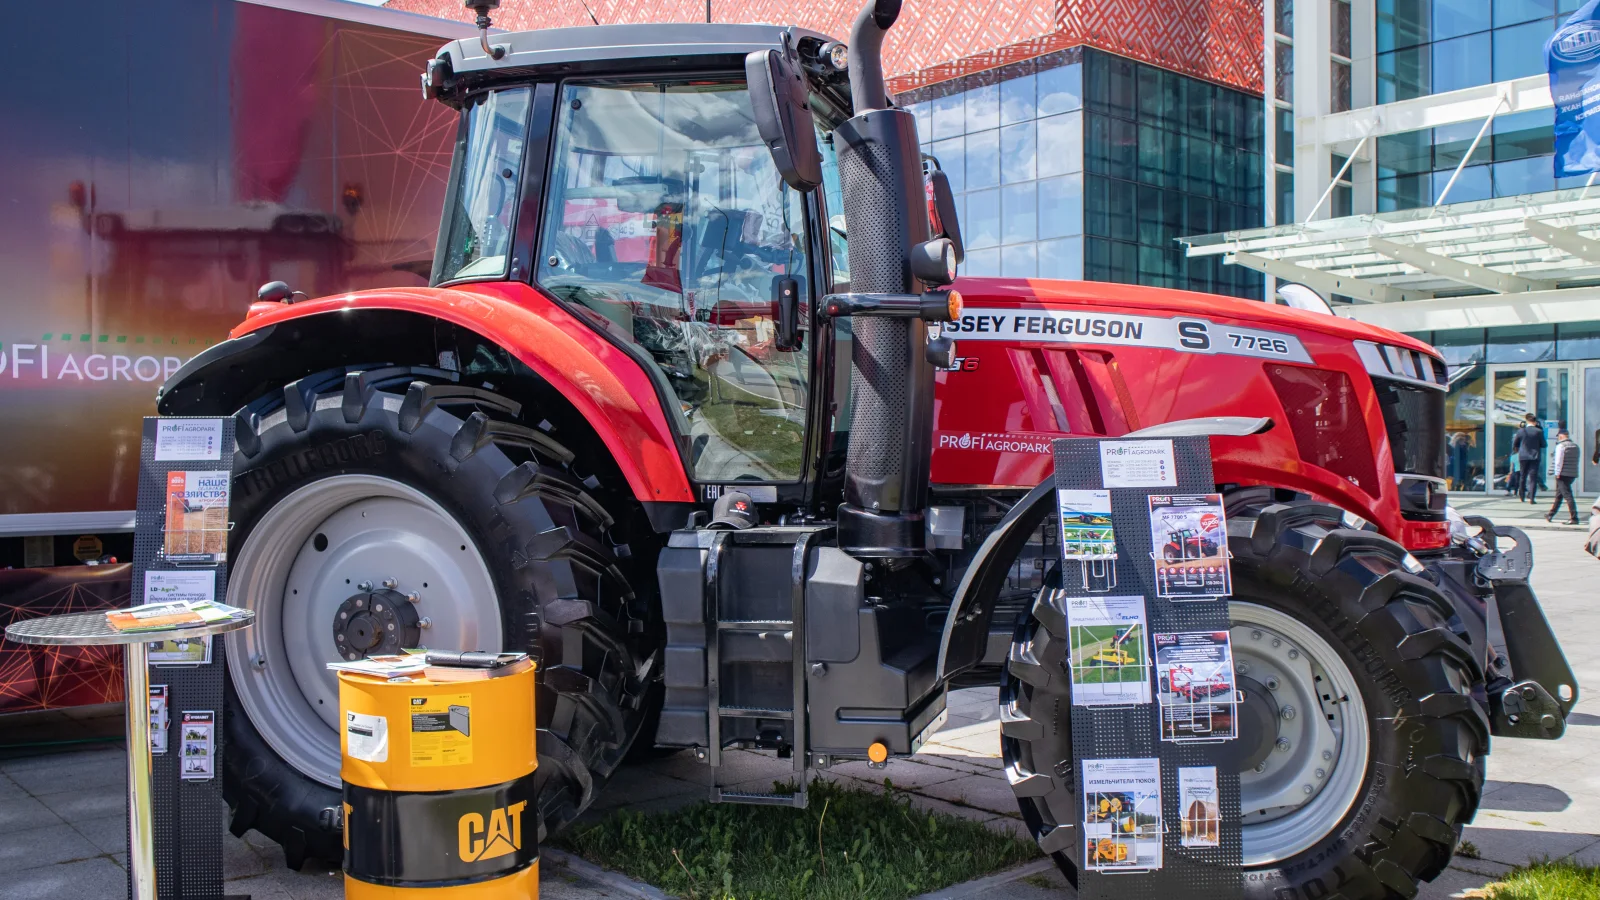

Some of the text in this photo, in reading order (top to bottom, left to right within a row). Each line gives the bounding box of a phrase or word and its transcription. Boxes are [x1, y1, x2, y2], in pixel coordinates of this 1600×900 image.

[942, 316, 1288, 354] SSEY FERGUSON S 7726
[163, 424, 184, 432] PROFI
[939, 433, 1051, 454] PROFI AGROPARK
[1106, 447, 1131, 456] PROFI
[458, 800, 527, 863] CAT
